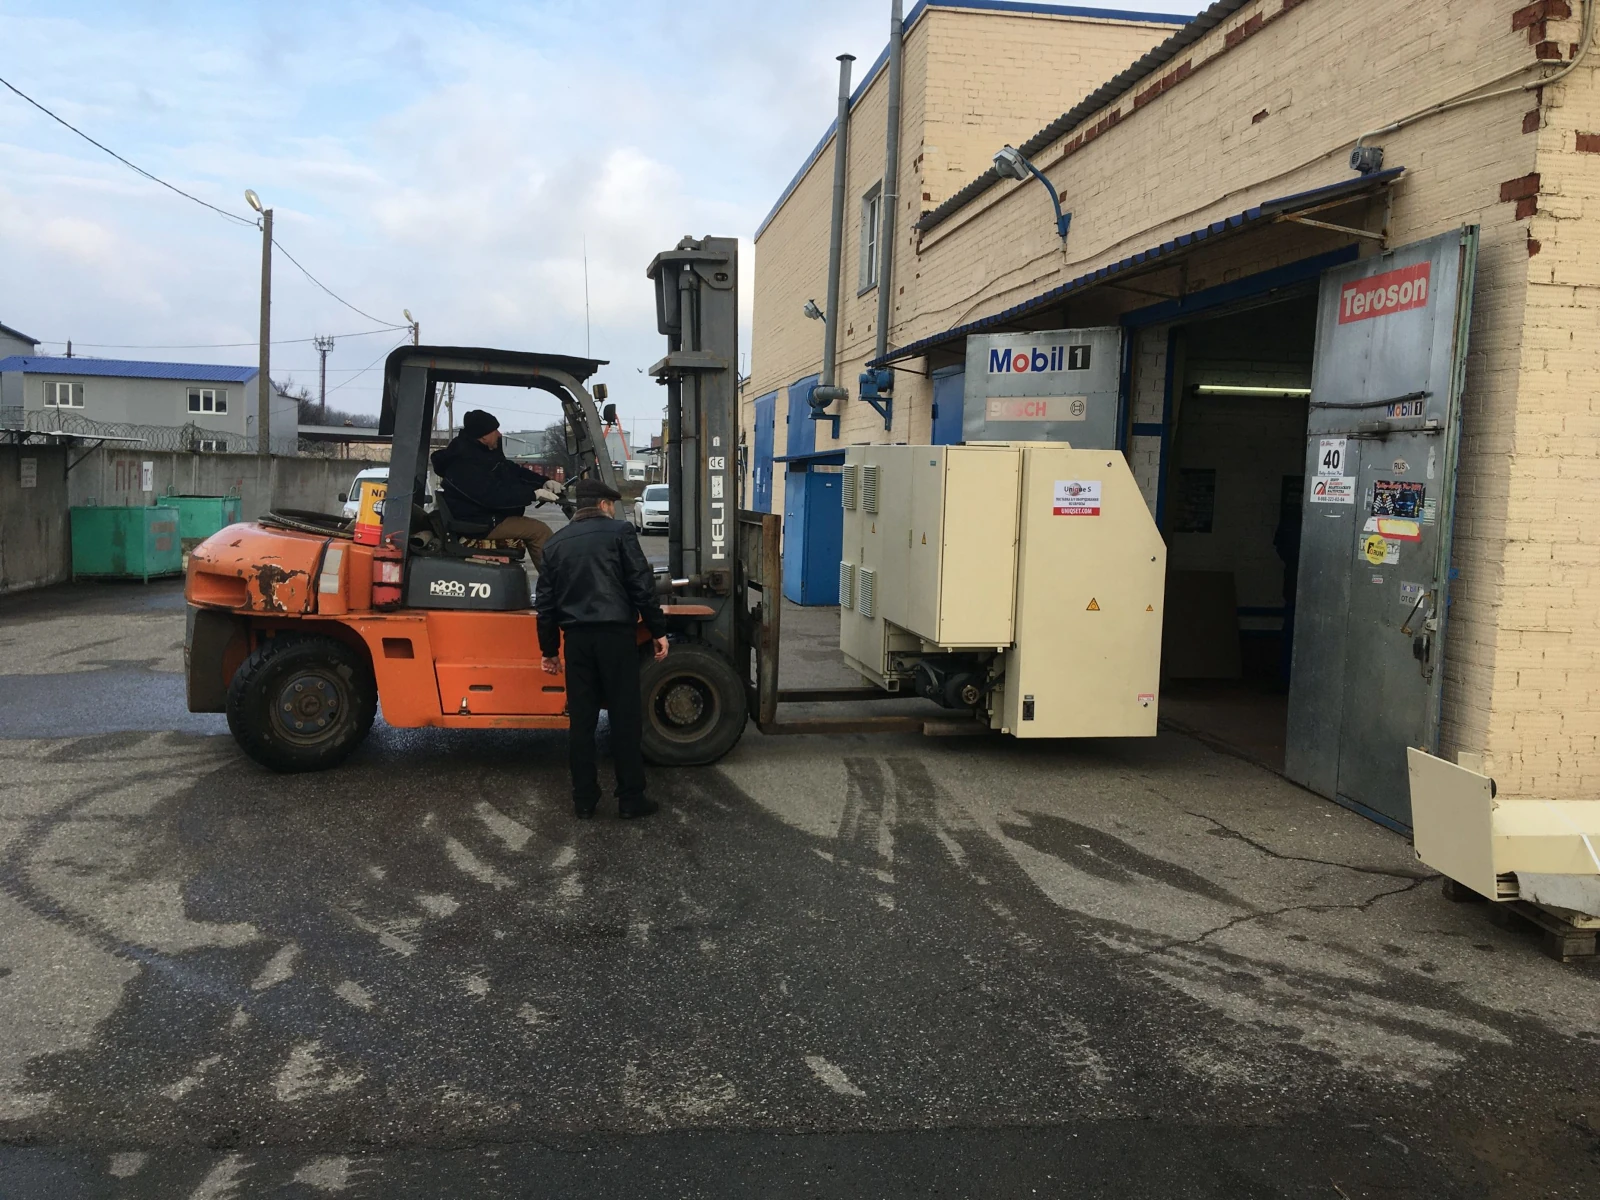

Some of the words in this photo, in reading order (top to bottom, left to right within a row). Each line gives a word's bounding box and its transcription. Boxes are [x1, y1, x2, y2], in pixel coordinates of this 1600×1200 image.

[1343, 277, 1426, 316] Teroson
[989, 346, 1064, 373] Mobil
[1074, 347, 1083, 368] 1
[990, 401, 1047, 417] BOSCH
[1386, 402, 1412, 417] Mobil
[1323, 449, 1340, 469] 40
[1393, 462, 1406, 470] RUS
[1064, 486, 1086, 494] Unique
[430, 580, 466, 594] h2000
[468, 582, 491, 598] 70
